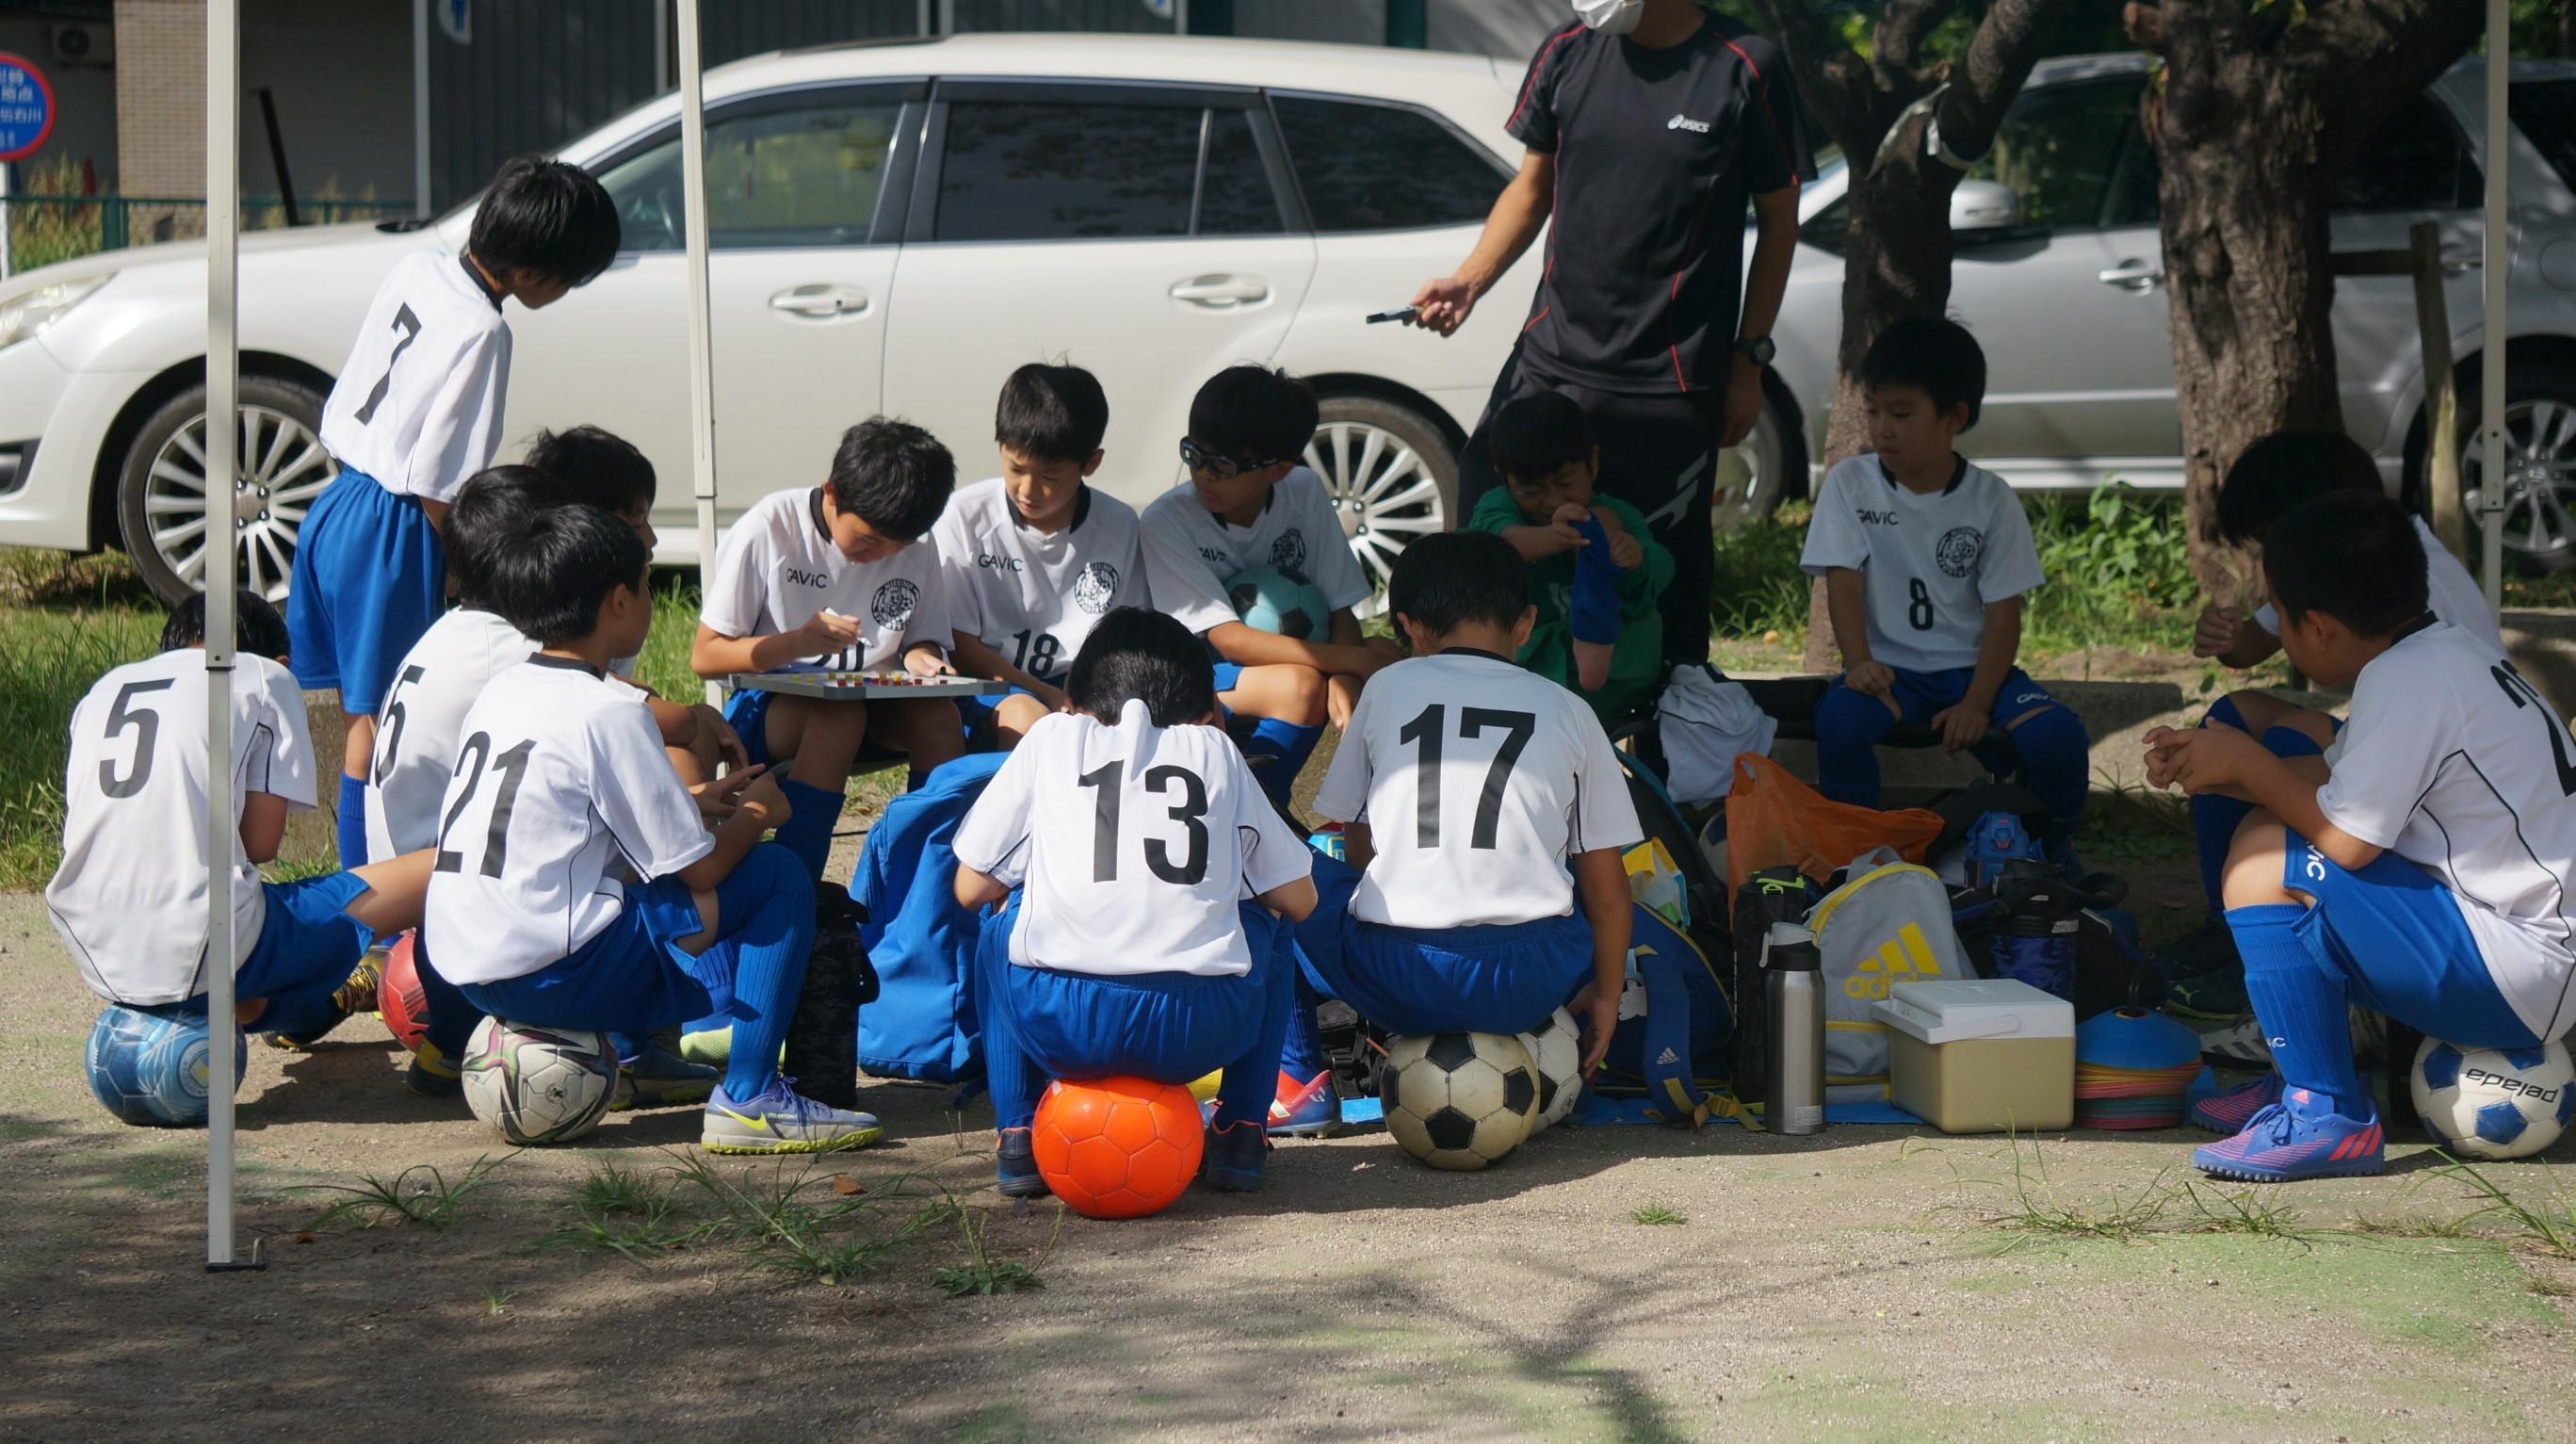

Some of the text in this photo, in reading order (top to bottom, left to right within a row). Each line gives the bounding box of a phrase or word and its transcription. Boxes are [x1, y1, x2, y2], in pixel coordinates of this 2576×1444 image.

[1679, 119, 1710, 133] asics
[354, 301, 422, 426] 7
[1013, 628, 1060, 679] 18
[1909, 577, 1934, 631] 8
[100, 678, 174, 798] 5
[365, 662, 426, 789] 5
[1400, 704, 1536, 850] 17
[433, 731, 538, 880] 21
[1078, 760, 1209, 885] 13
[2466, 1068, 2559, 1103] pelada
